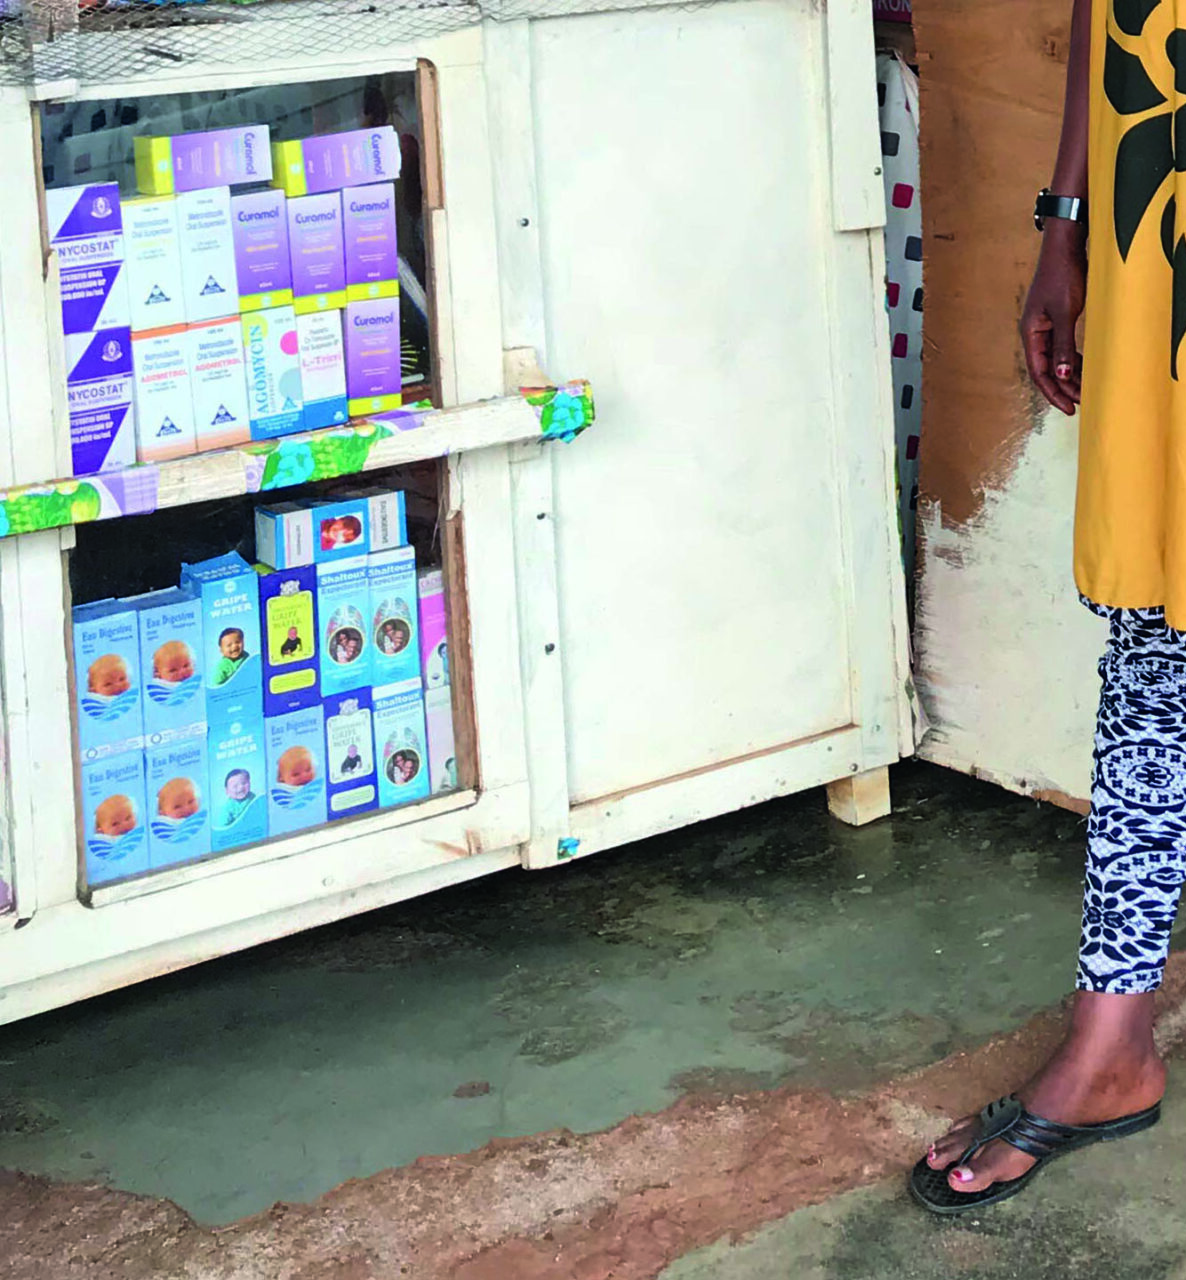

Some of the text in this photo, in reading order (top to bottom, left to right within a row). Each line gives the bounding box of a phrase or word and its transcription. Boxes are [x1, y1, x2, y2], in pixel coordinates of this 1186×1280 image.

[244, 132, 257, 176] Curamol
[372, 133, 385, 176] Curamol
[350, 198, 390, 212] Curamol
[238, 206, 279, 222] Curamol
[295, 209, 336, 224] Curamol
[58, 240, 115, 257] NYCOSTAT
[354, 312, 394, 326] Curamol
[250, 325, 269, 414] AGOMYCIN
[68, 383, 124, 401] NYCOSTAT
[213, 593, 248, 607] GRIPE
[210, 603, 253, 618] WATER
[218, 734, 254, 750] GRIPE
[216, 744, 257, 760] WATER
